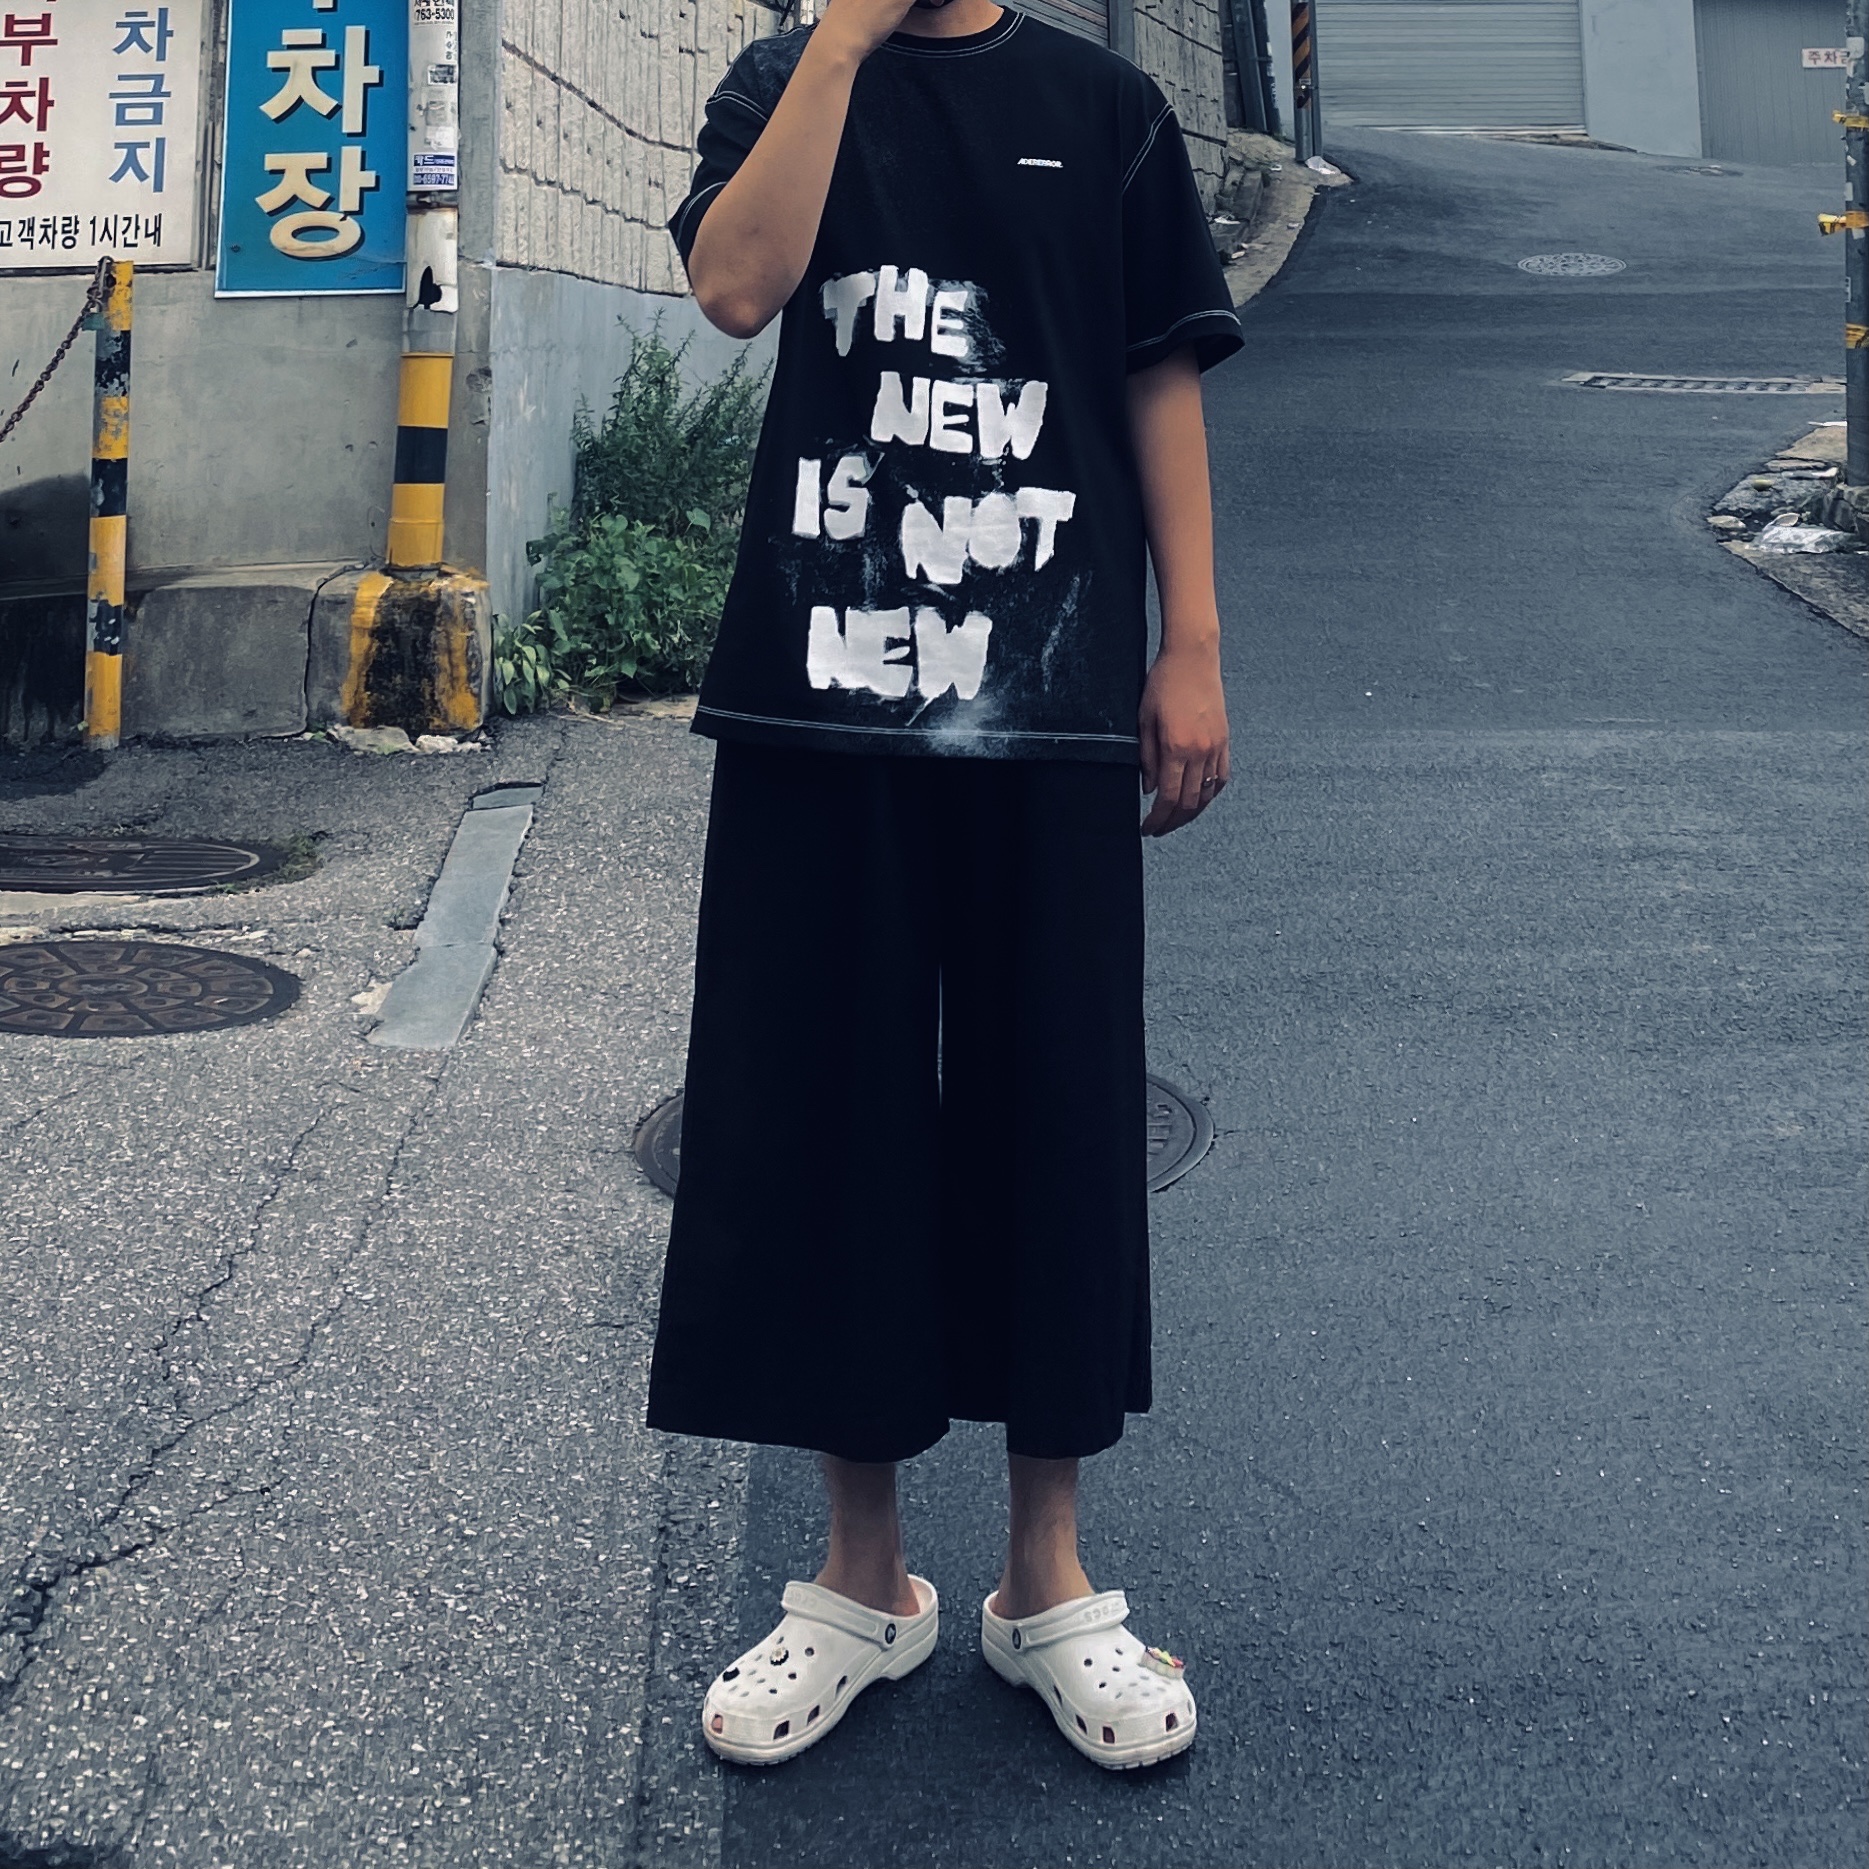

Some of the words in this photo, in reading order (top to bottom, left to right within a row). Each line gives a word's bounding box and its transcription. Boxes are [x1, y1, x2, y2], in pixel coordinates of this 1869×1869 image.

[0, 0, 58, 198] 부차량
[255, 0, 380, 258] 차장
[0, 214, 80, 250] 고객차량
[89, 212, 163, 249] 1시간내
[822, 264, 974, 357] THE
[870, 371, 1049, 461] NEW
[791, 455, 870, 541] IS
[901, 486, 1077, 586] NOT
[806, 605, 993, 701] NEW
